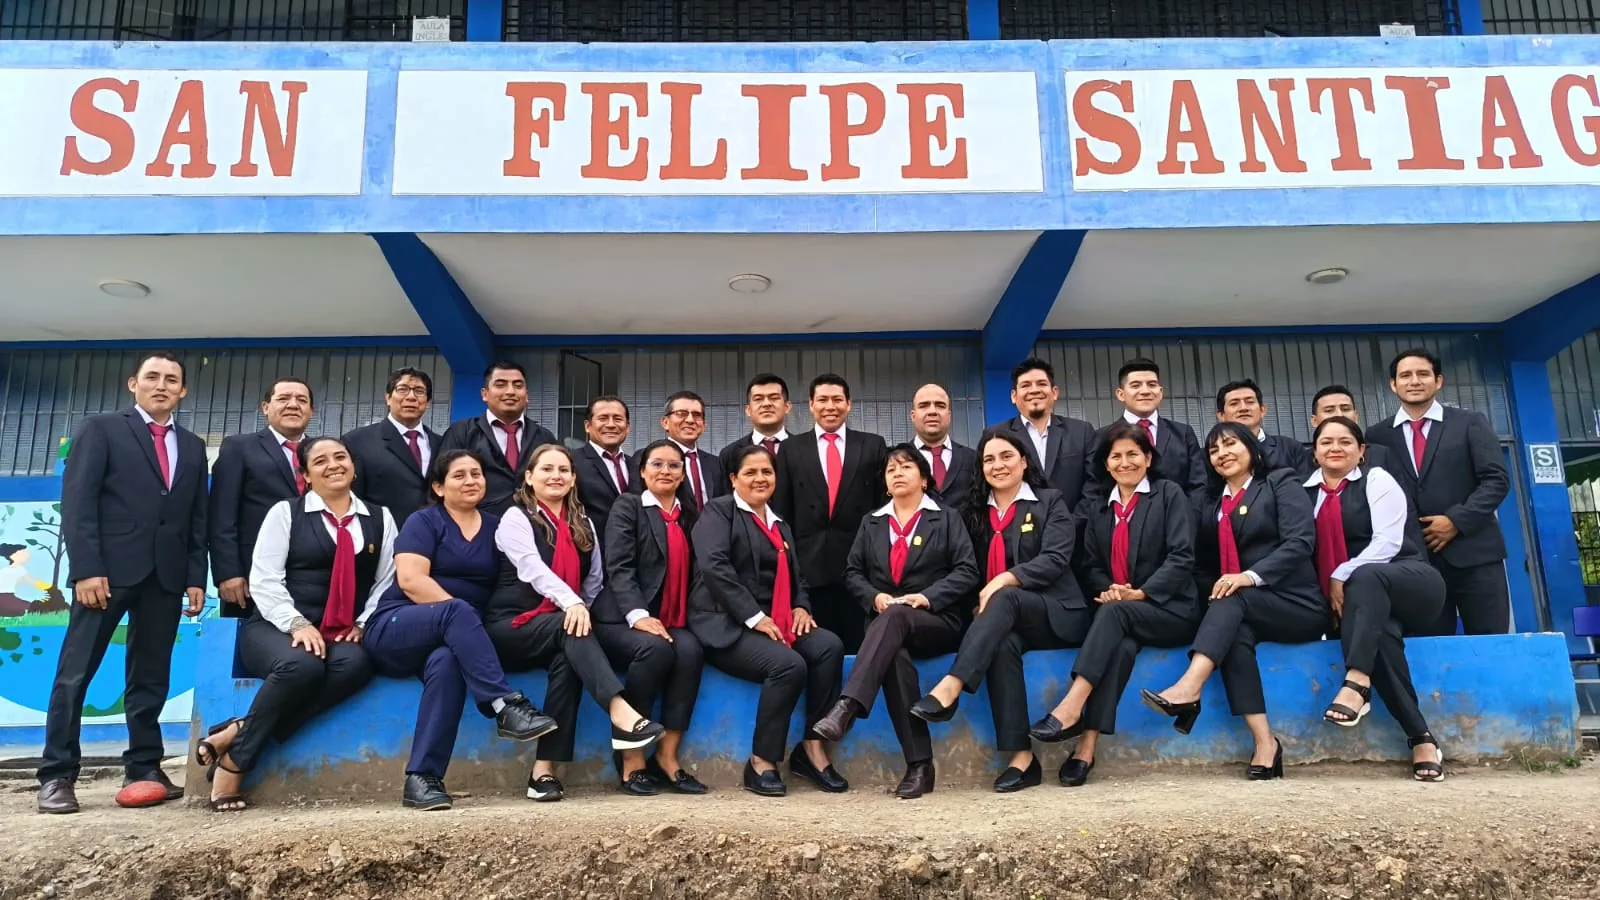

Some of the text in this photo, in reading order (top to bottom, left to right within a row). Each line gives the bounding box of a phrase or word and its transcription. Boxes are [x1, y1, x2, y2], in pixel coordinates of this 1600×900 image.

[63, 76, 1600, 181] SAN FELIPE SANTIAG
[1536, 448, 1553, 466] S
